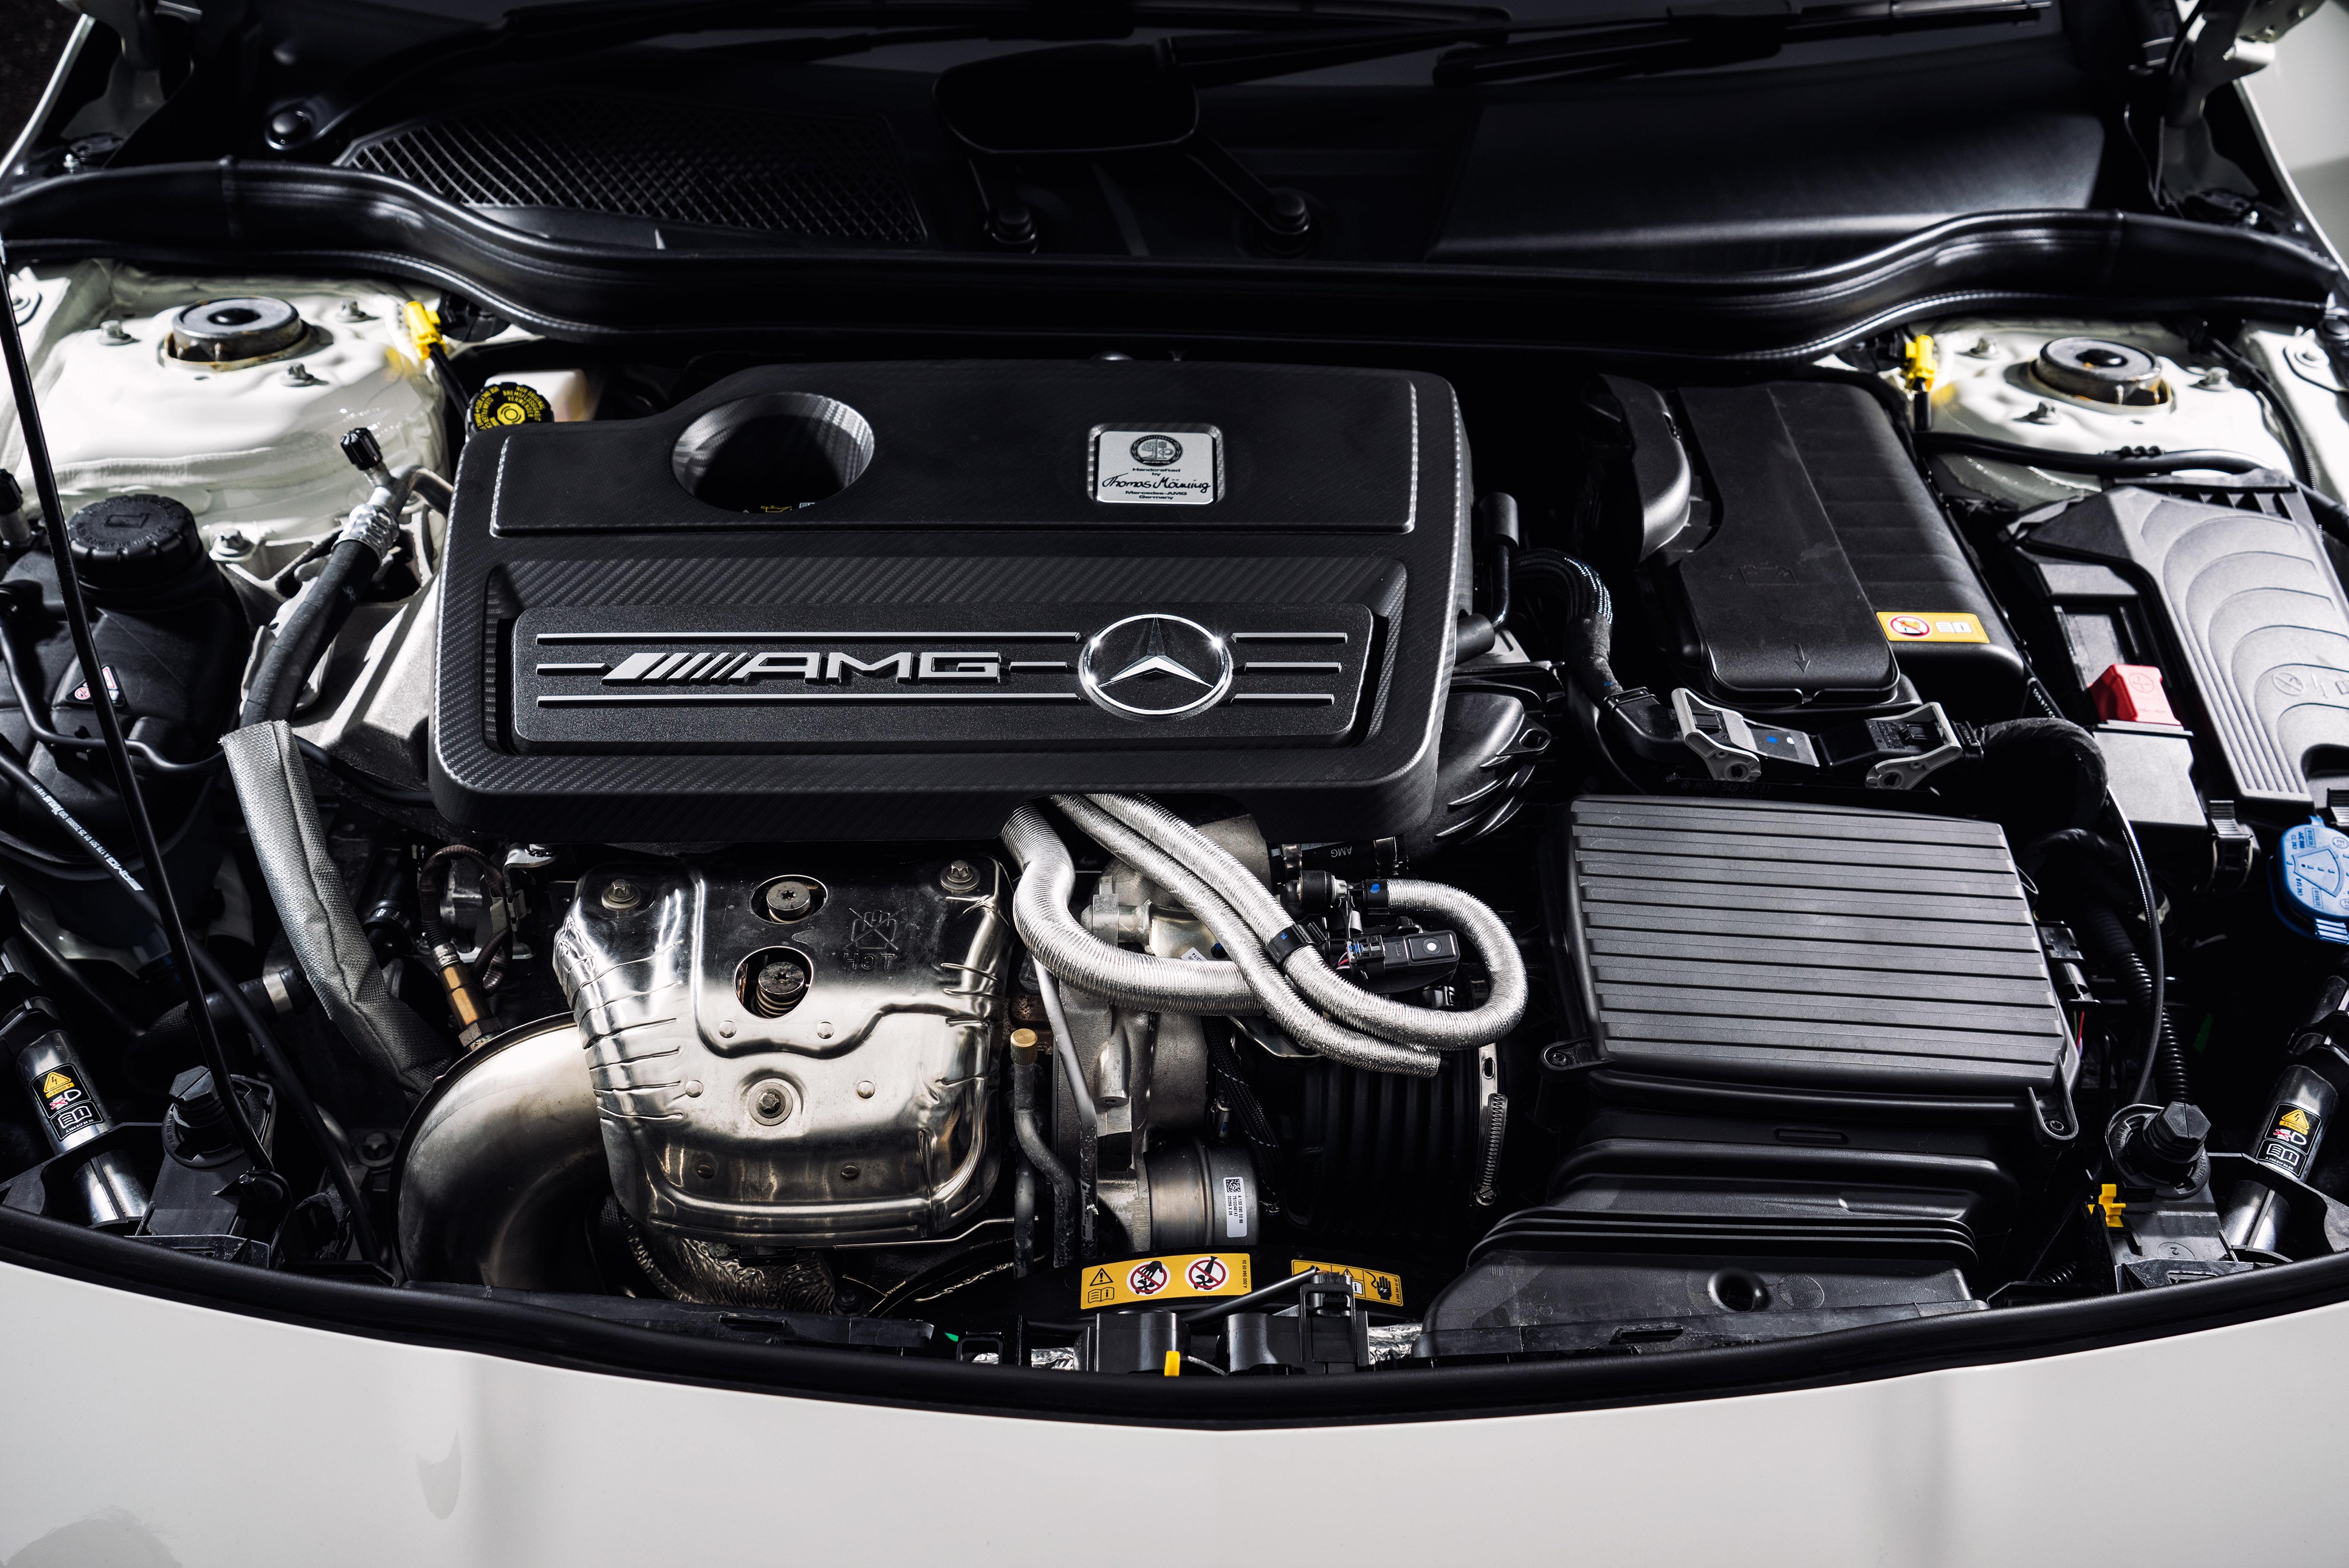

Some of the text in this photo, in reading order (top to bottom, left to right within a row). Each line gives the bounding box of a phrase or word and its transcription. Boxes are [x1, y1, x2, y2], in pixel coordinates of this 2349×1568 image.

[1102, 473, 1152, 488] Thomas
[728, 652, 1000, 684] AMG
[89, 839, 99, 848] 501
[1330, 846, 1352, 858] AMG
[844, 953, 897, 970] HOT
